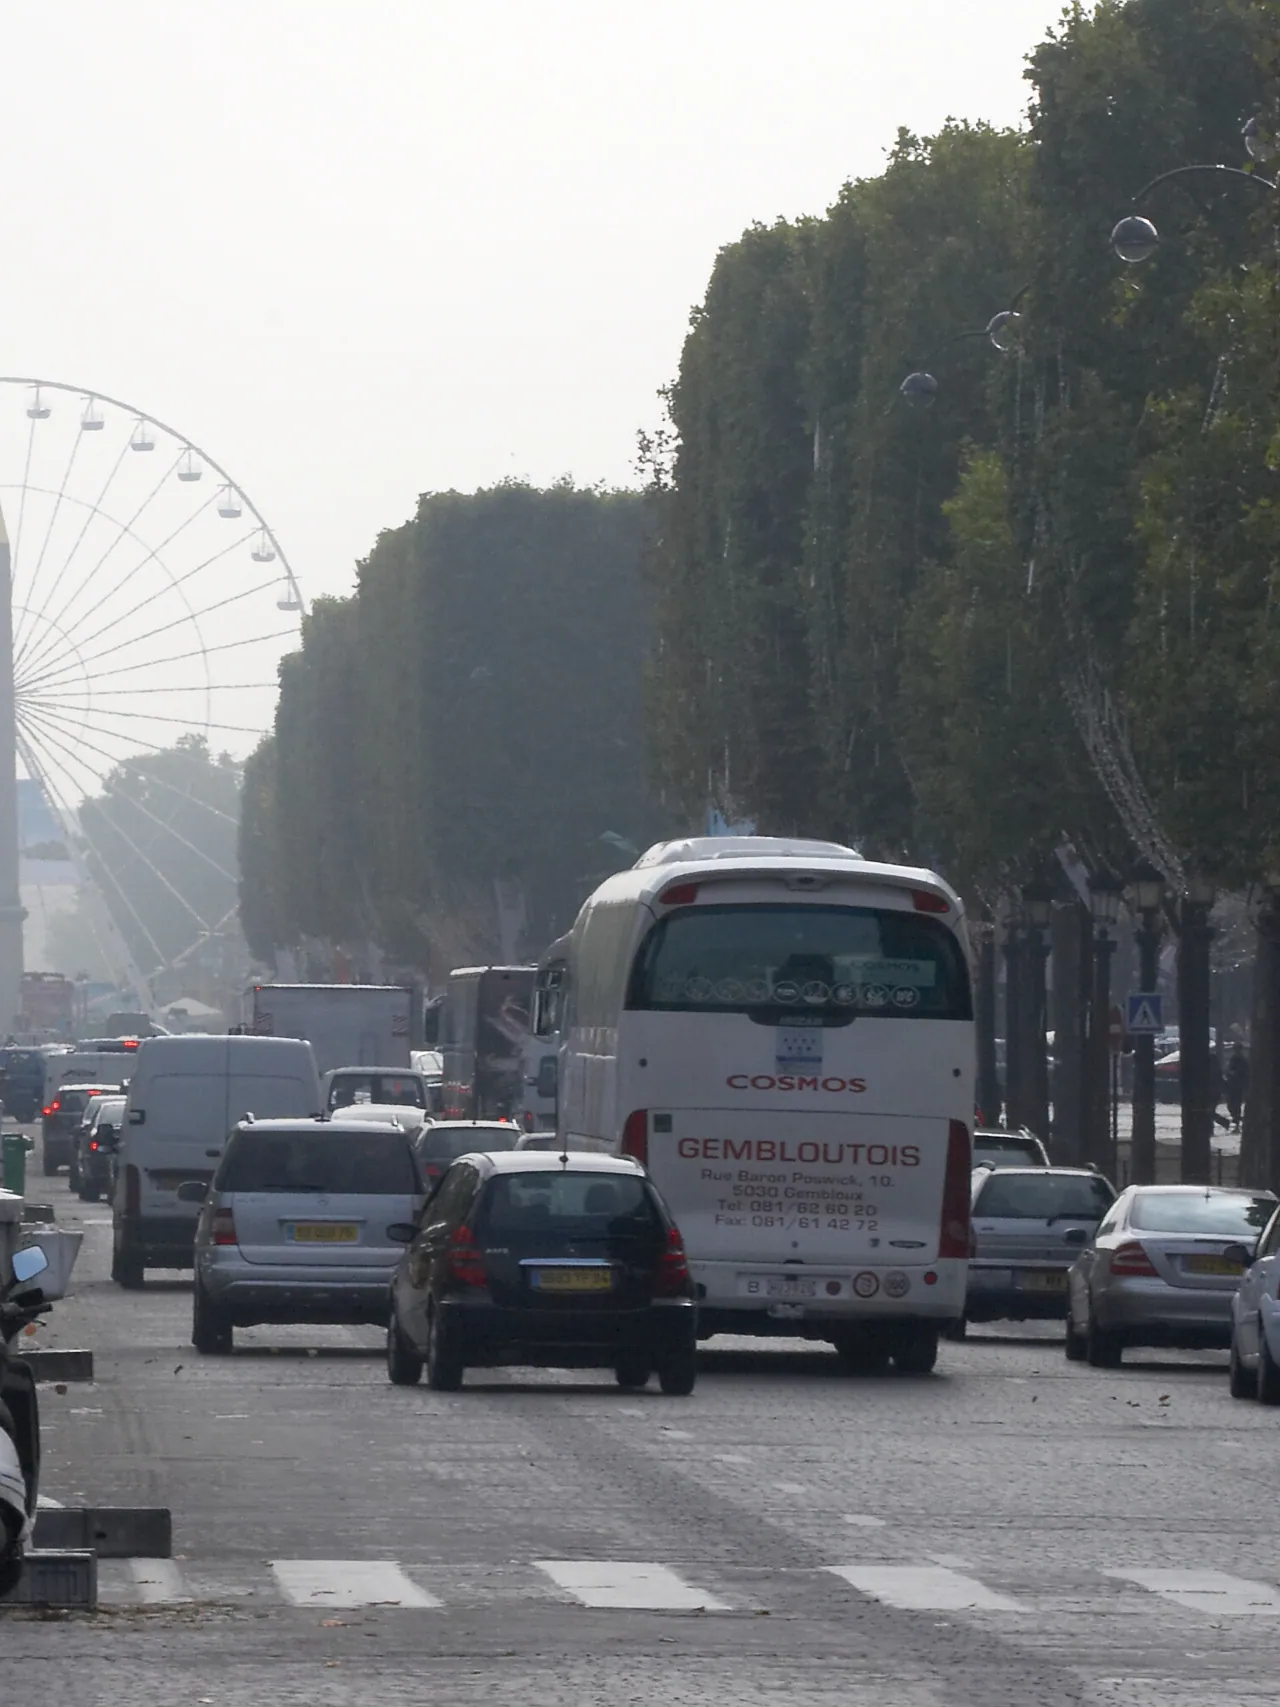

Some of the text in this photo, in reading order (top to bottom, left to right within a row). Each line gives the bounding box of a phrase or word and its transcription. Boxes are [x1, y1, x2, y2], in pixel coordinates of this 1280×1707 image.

[726, 1075, 867, 1093] COSMOS
[678, 1137, 921, 1168] GEMBLOUTOIS
[701, 1169, 732, 1181] Rue
[737, 1170, 786, 1184] Baron
[732, 1185, 863, 1201] 5030 Gembloux
[854, 1204, 878, 1216] 20
[827, 1218, 850, 1230] 42
[857, 1219, 879, 1231] 72
